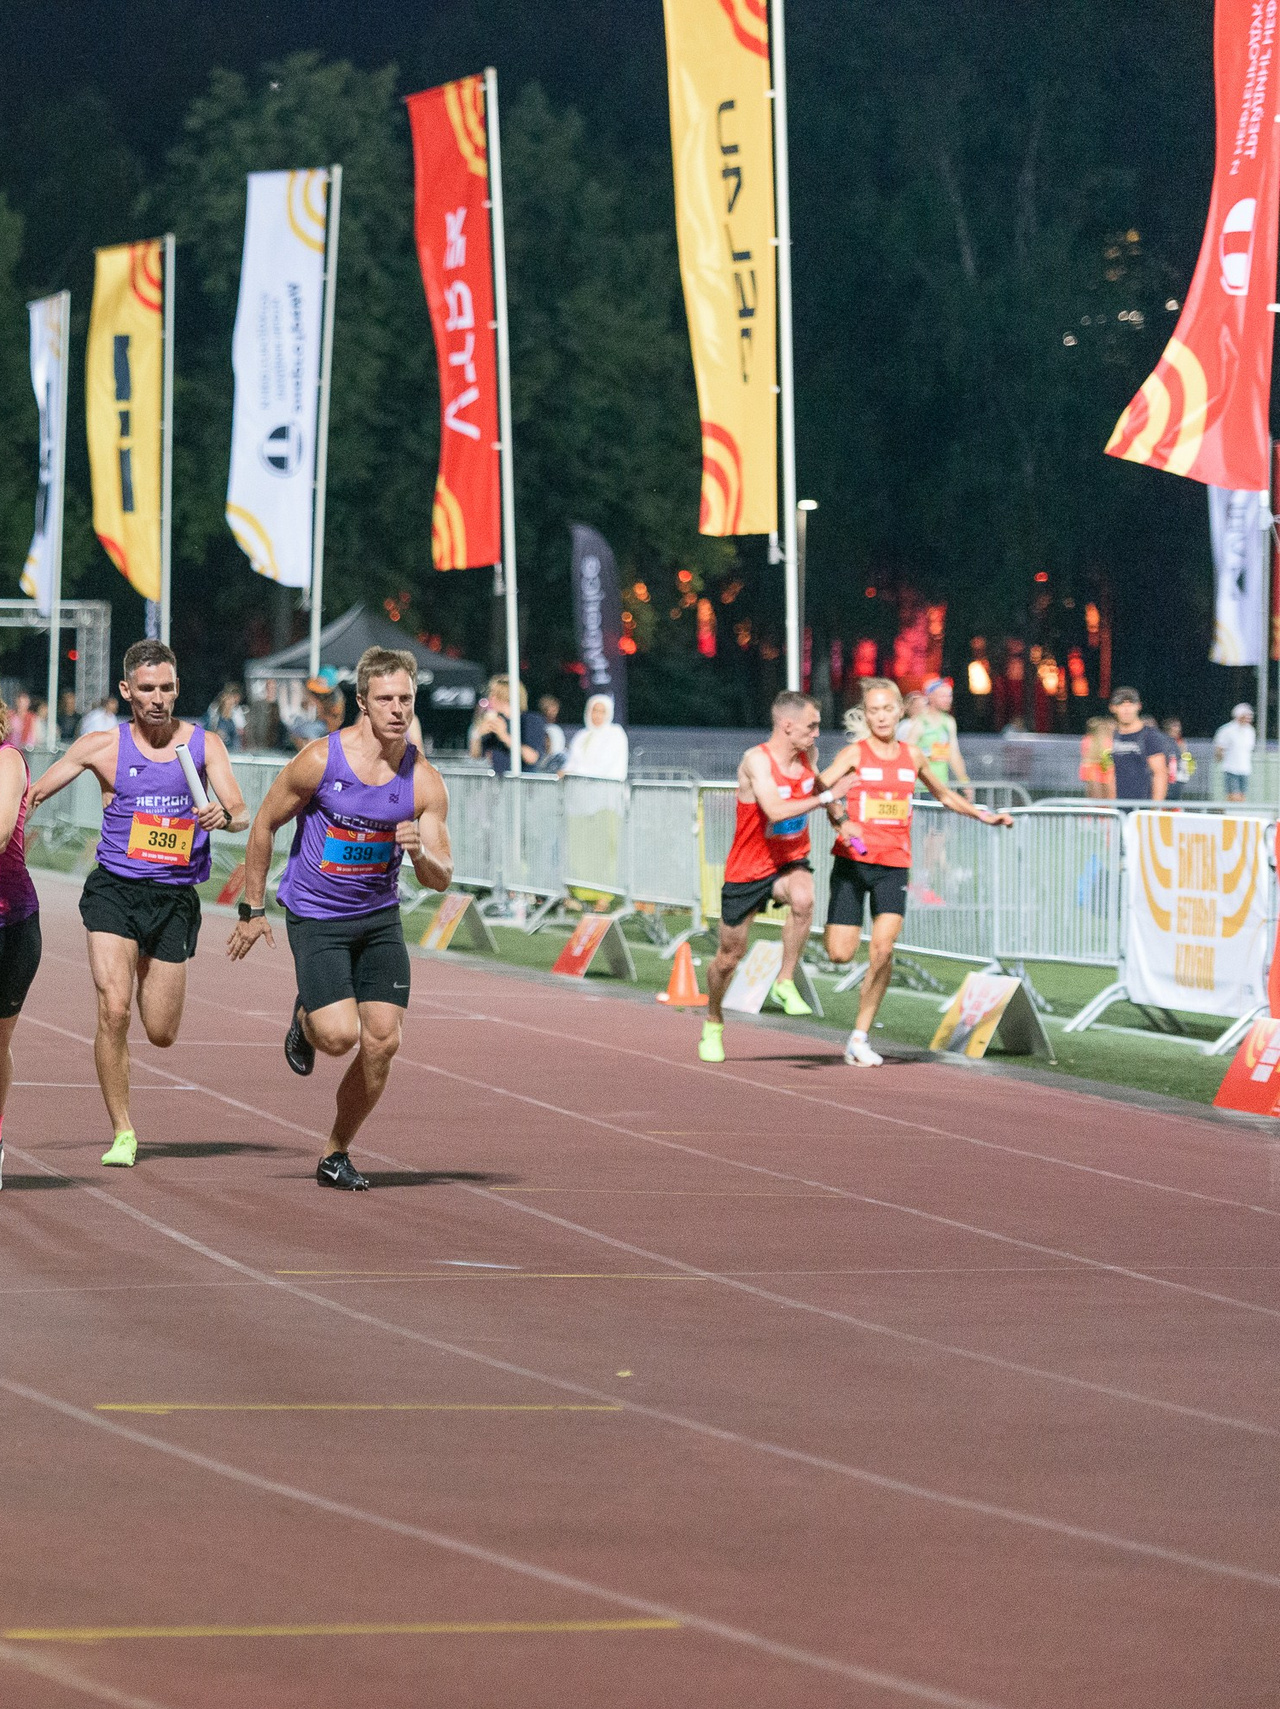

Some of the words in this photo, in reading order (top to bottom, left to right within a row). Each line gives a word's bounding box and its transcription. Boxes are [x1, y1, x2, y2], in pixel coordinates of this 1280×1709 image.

[148, 830, 177, 849] 339
[181, 841, 187, 850] 2
[342, 846, 373, 861] 339
